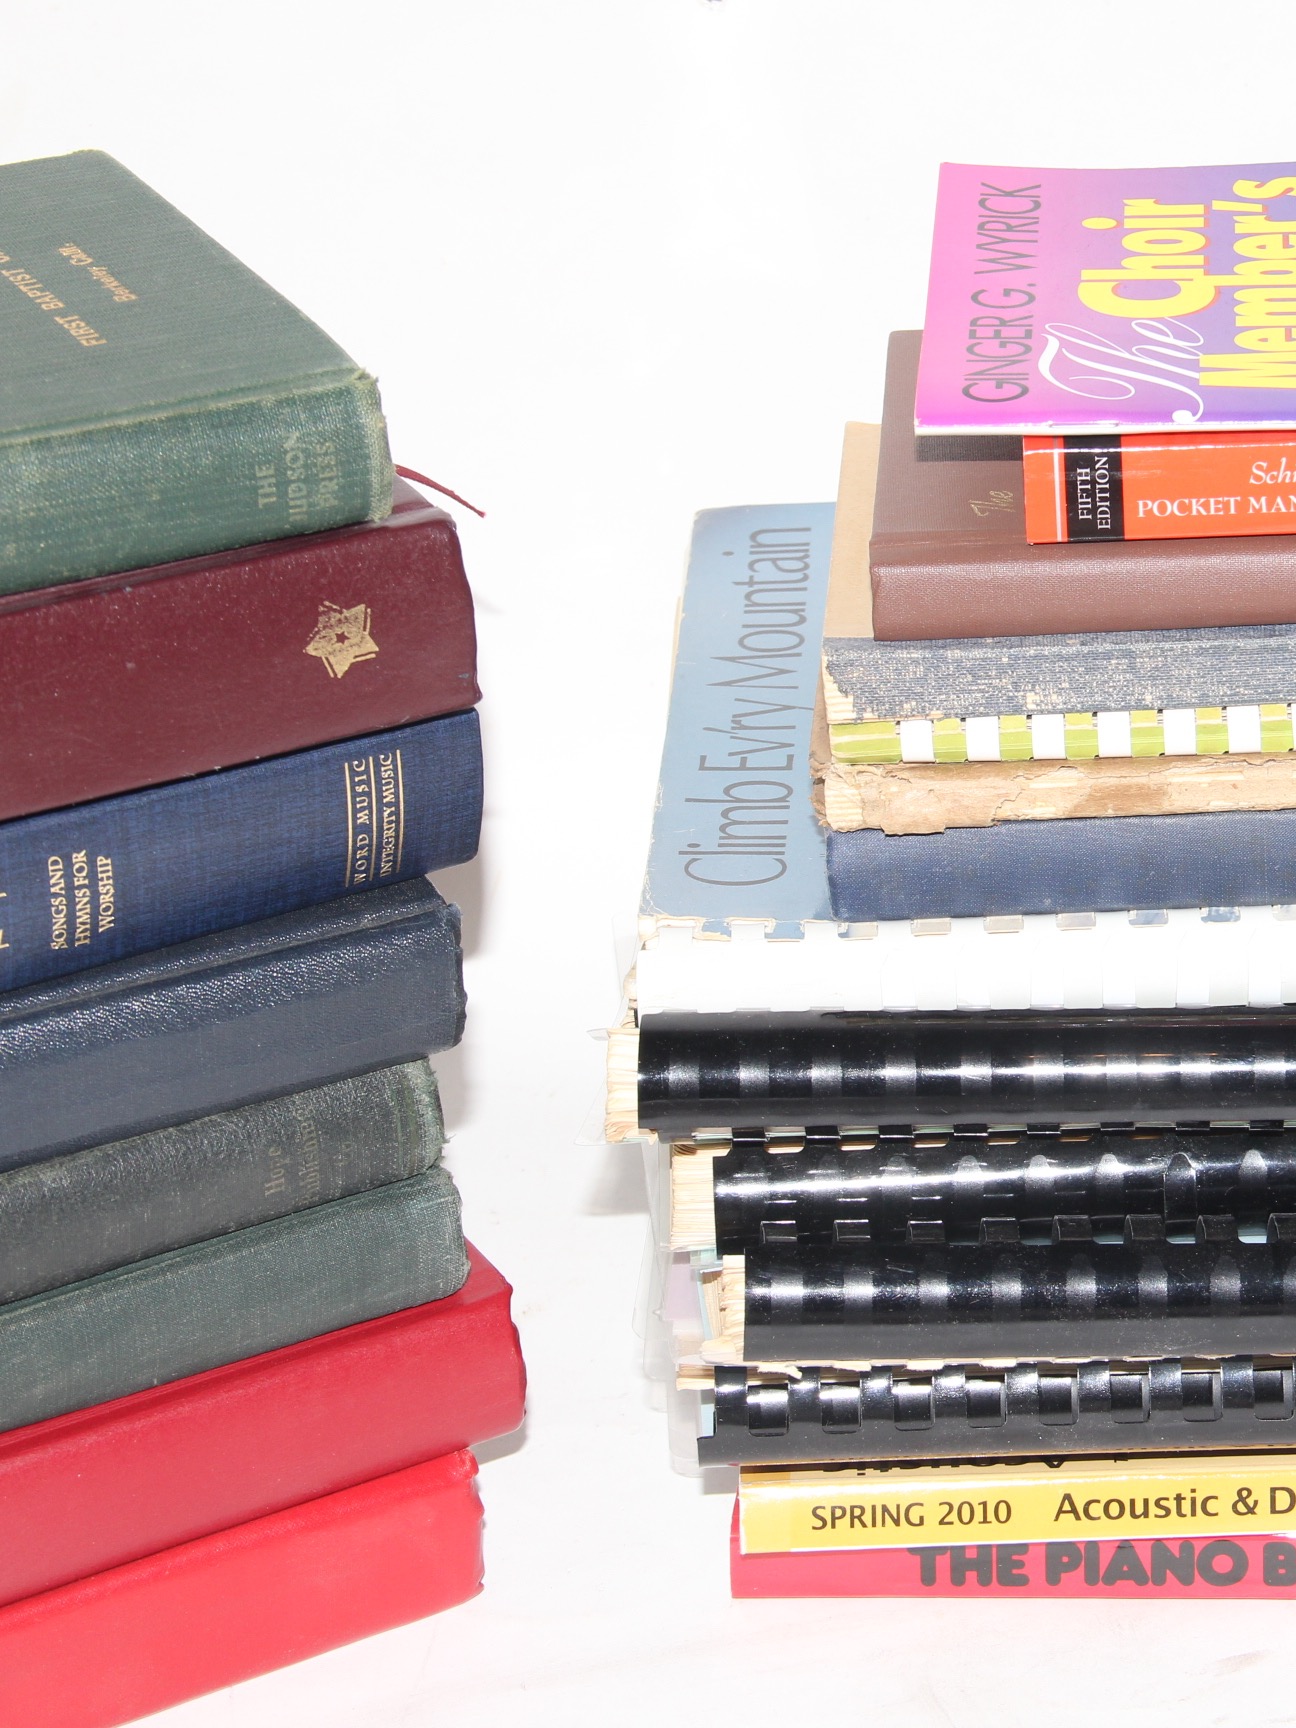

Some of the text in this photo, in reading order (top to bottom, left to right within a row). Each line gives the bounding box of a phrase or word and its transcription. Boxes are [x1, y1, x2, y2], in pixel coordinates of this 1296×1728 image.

[961, 182, 1043, 403] GINGER G. WYRICK
[1077, 198, 1217, 318] Choir
[0, 268, 108, 346] FIRST BAPTIST
[1038, 317, 1204, 423] The
[255, 463, 277, 508] THE
[315, 441, 339, 508] PRESS
[1078, 467, 1092, 520] FIFTH
[1095, 456, 1112, 530] EDITION
[1137, 495, 1240, 518] POCKET
[678, 527, 814, 887] Climb Ev'ry Mountain
[352, 759, 369, 885] WORD MUSIC
[379, 753, 395, 877] INTEGRITY MUSIC
[48, 856, 67, 949] SONGS AND
[72, 850, 91, 947] HYMNS FOR
[97, 856, 115, 933] WORSHIP
[811, 1501, 925, 1531] SPRING
[938, 1498, 1013, 1527] 2010
[1053, 1487, 1218, 1522] Acoustic
[1231, 1487, 1260, 1516] &
[907, 1544, 1030, 1589] THE
[1045, 1541, 1249, 1588] PIANO
